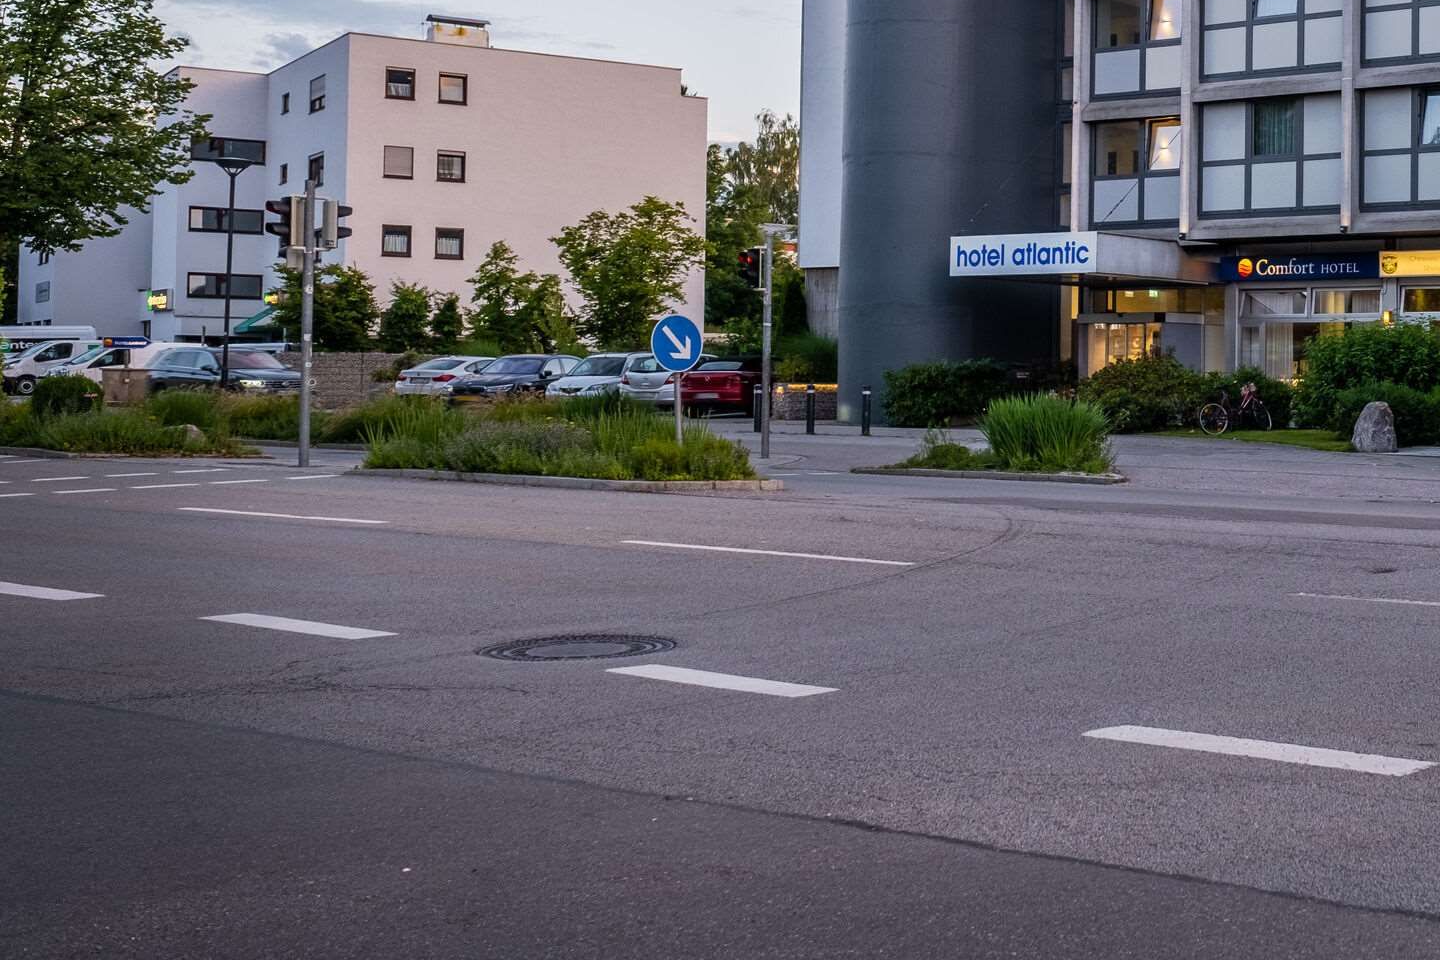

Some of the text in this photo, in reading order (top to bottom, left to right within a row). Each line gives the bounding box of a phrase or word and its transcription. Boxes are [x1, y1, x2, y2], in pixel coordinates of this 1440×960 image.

[956, 241, 1089, 267] hotel atlantic
[1256, 257, 1360, 276] Comfort HOTEL
